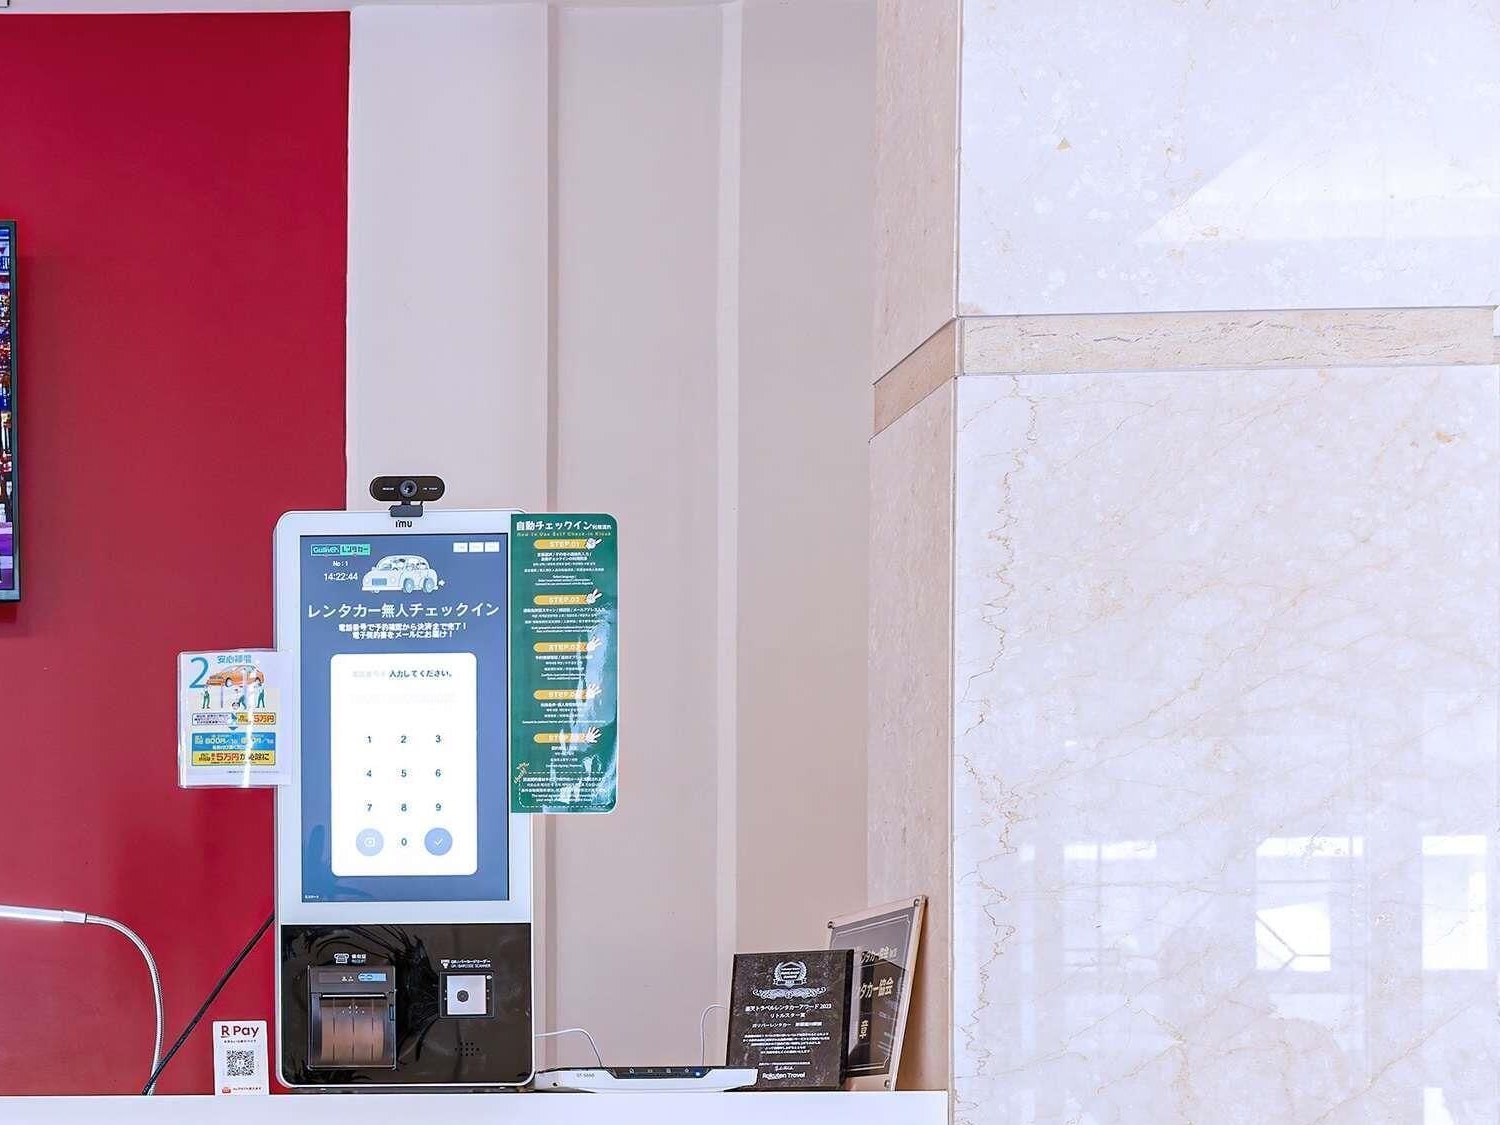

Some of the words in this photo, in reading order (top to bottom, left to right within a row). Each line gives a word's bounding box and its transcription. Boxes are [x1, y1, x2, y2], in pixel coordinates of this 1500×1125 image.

[323, 573, 358, 581] 14:22:44
[307, 602, 499, 618] レンタカー無人チェックイン
[189, 657, 209, 688] 2
[221, 1025, 230, 1038] R
[233, 1026, 259, 1038] Pay
